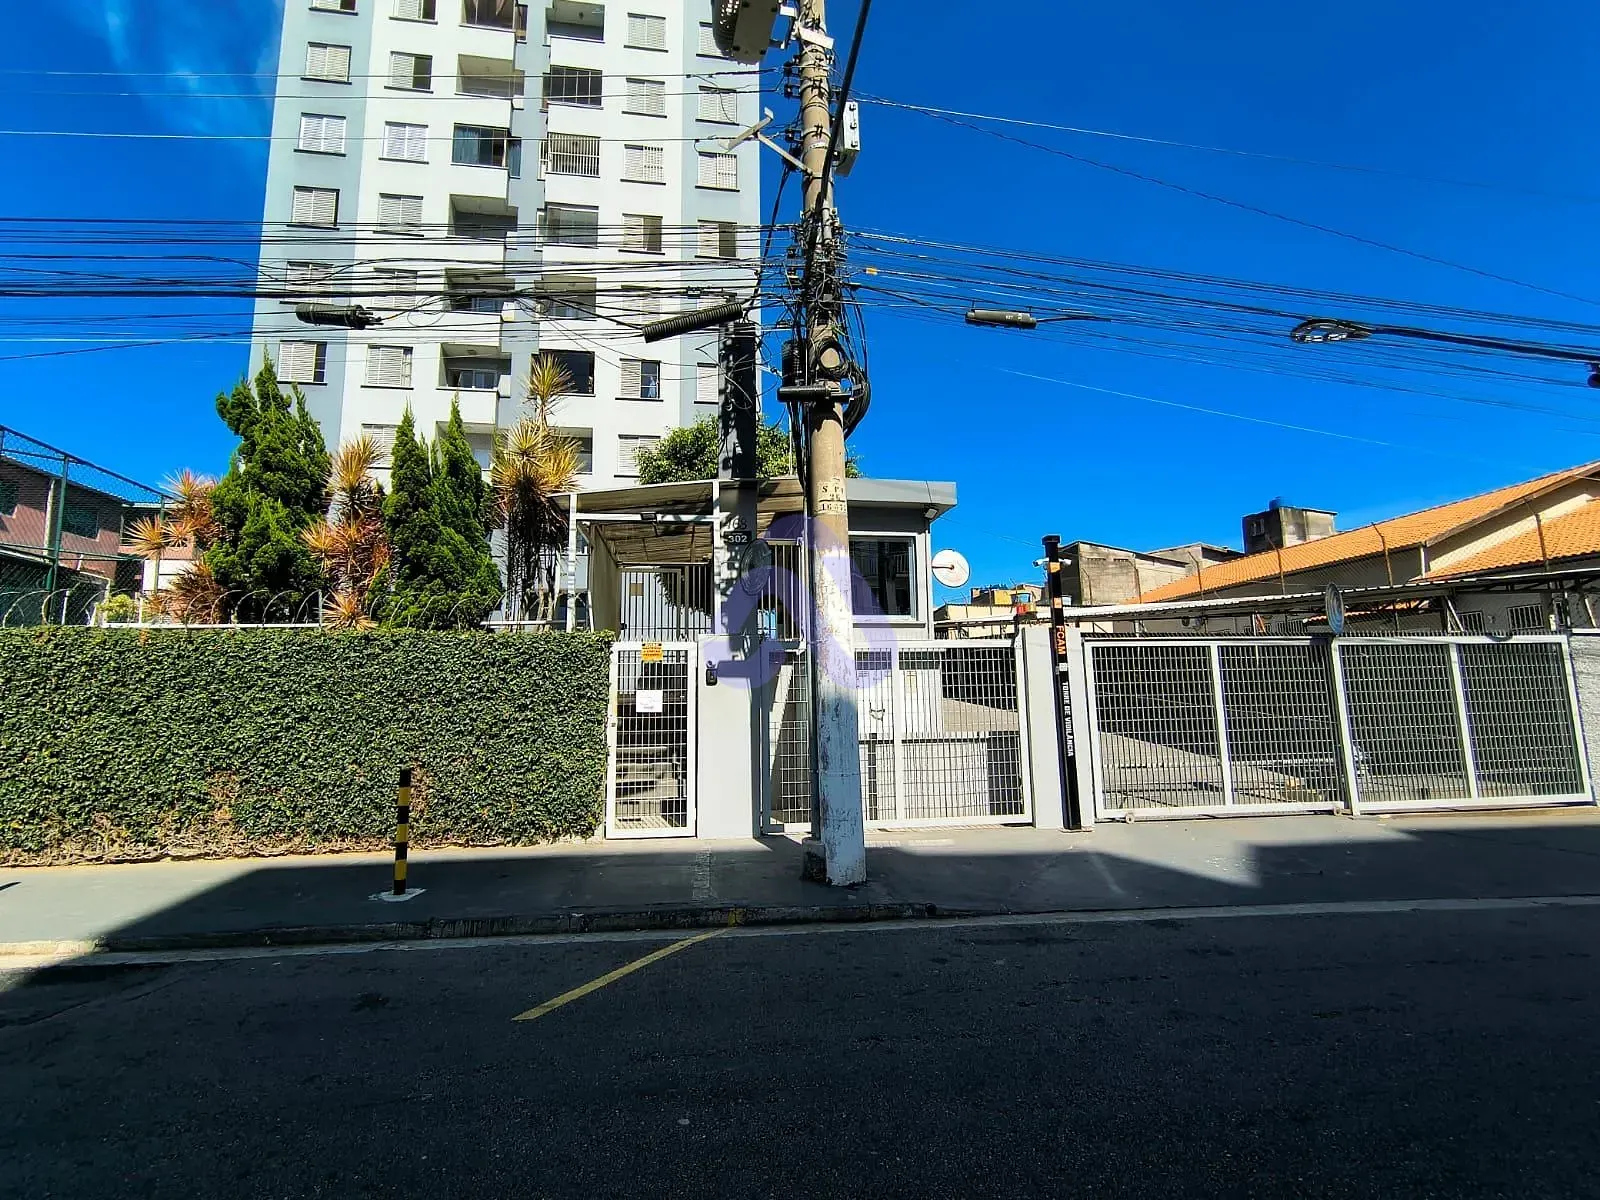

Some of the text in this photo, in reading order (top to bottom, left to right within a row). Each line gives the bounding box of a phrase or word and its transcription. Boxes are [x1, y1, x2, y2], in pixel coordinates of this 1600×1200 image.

[728, 535, 748, 543] 302
[1056, 625, 1066, 655] FCAM
[1062, 681, 1070, 705] TORRE
[1064, 705, 1071, 716] DE
